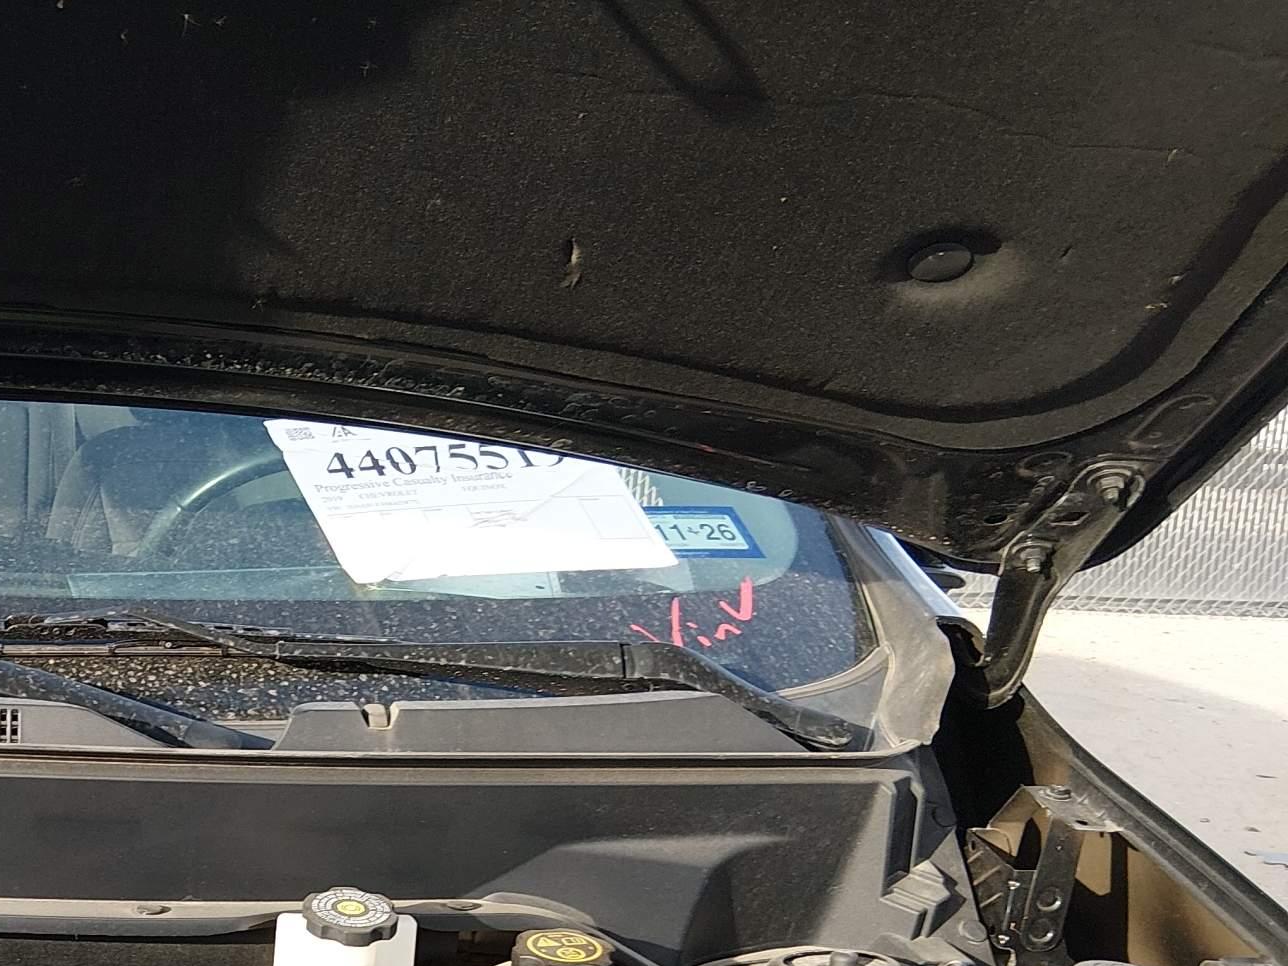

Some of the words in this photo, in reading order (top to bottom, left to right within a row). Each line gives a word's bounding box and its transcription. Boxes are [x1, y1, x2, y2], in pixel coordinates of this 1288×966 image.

[314, 479, 389, 494] Progressive
[393, 474, 448, 489] Casualty
[451, 470, 513, 483] Insurance
